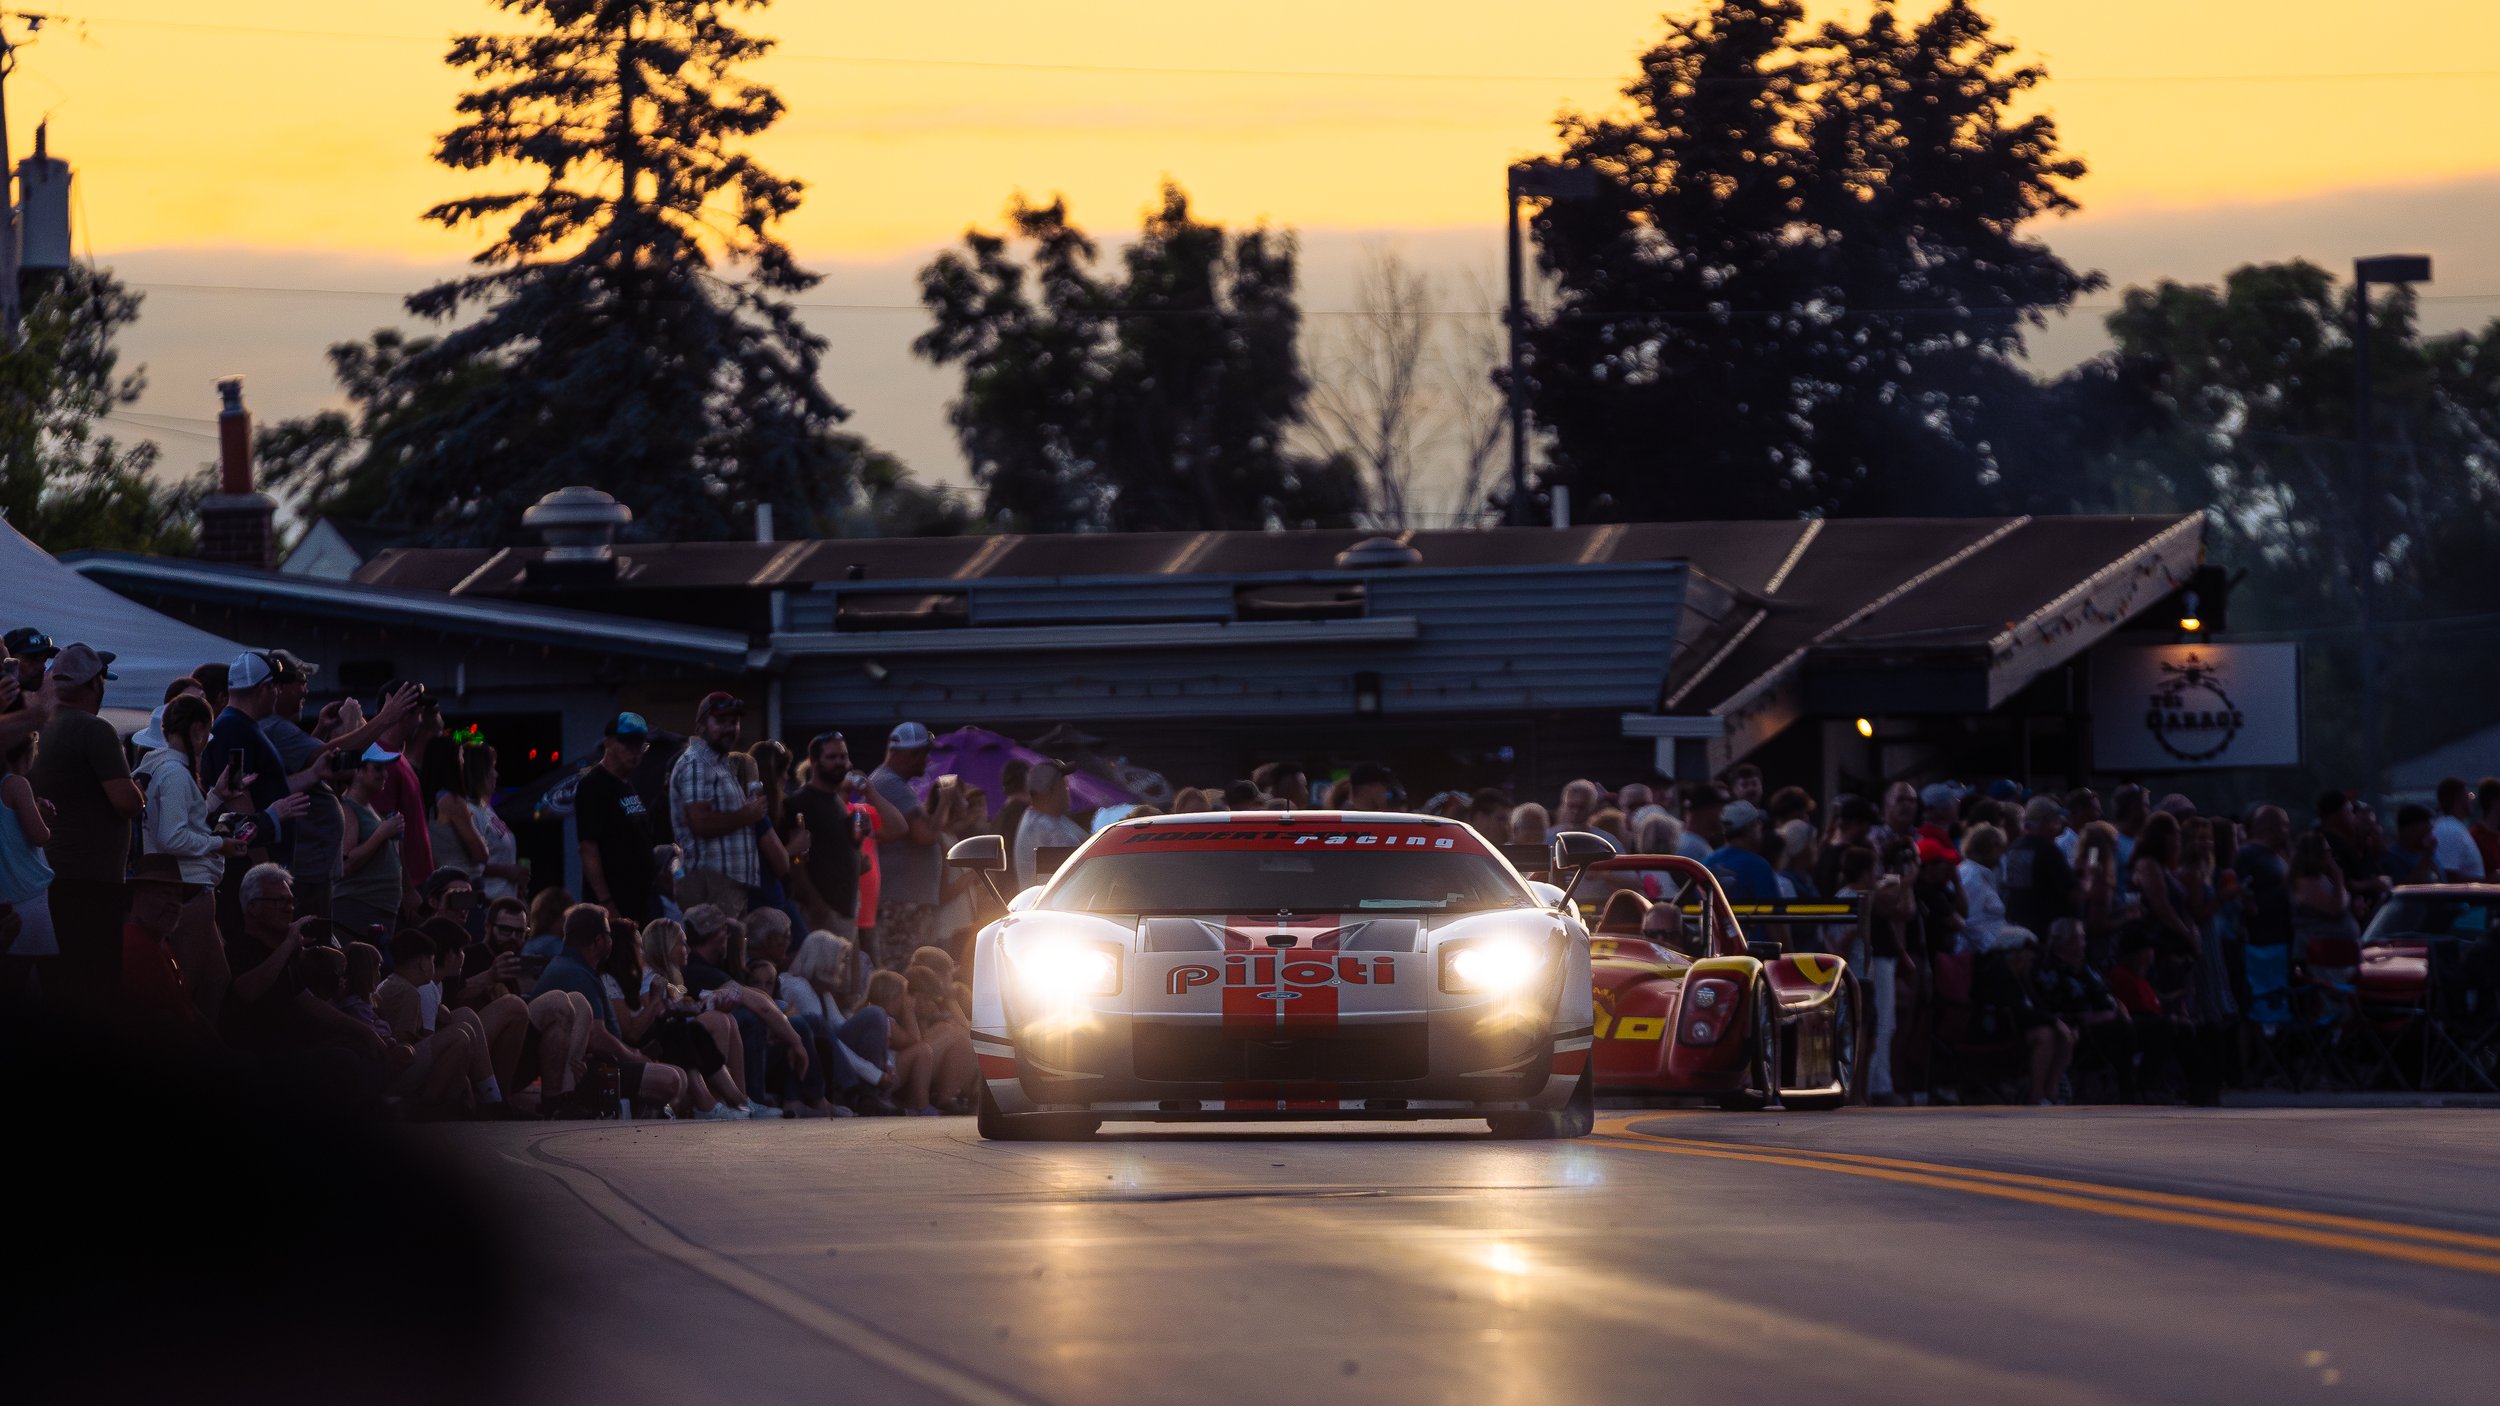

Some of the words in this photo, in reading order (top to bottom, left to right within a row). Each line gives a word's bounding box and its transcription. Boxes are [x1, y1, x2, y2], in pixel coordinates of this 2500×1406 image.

[2146, 710, 2243, 730] GARAGE
[1294, 835, 1454, 849] racing
[1166, 956, 1395, 994] piloti
